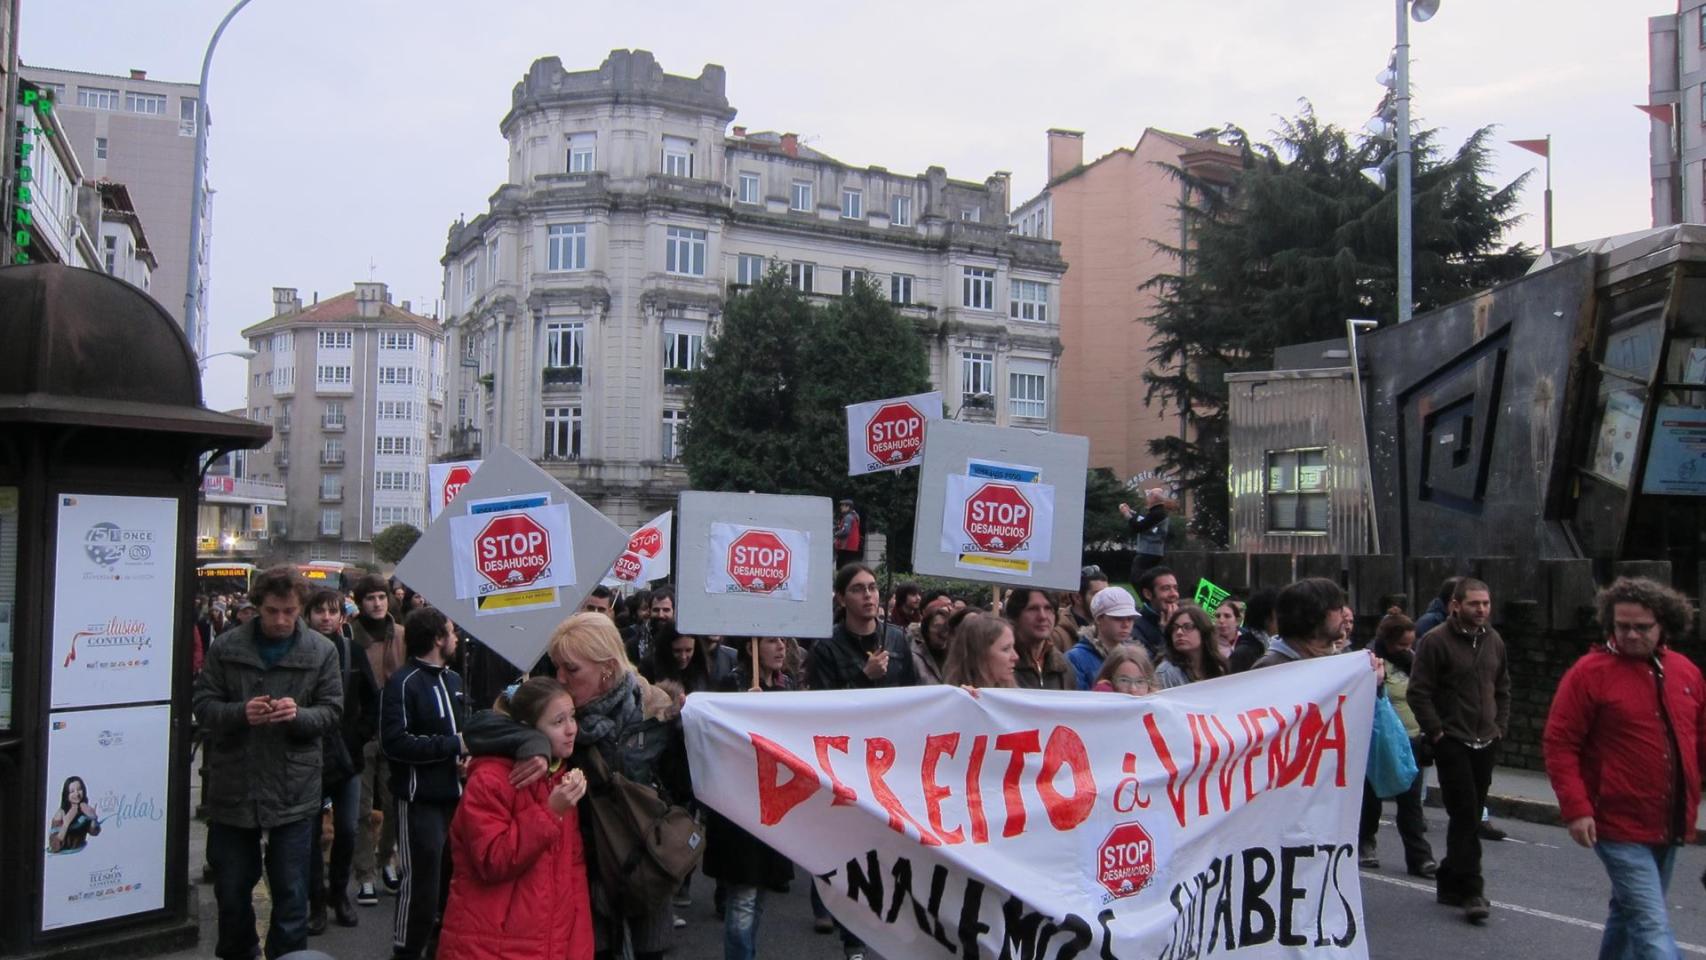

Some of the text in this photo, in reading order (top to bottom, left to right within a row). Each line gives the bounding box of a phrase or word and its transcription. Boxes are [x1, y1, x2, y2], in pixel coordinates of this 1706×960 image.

[15, 143, 34, 265] FORNOS
[872, 417, 920, 442] STOP
[872, 436, 920, 453] DESAHUCIOS
[446, 483, 466, 502] ST
[972, 500, 1027, 525] STOP
[123, 532, 153, 541] ONCE
[970, 522, 1025, 538] DESAHUCIOS
[482, 531, 542, 559] STOP
[631, 533, 659, 548] STOP
[484, 555, 545, 572] DESAHUCIOS
[617, 557, 641, 571] STOP
[734, 545, 786, 567] STOP
[733, 565, 784, 579] DESAHUCIOS
[748, 725, 1098, 847] DEREITO
[1142, 695, 1347, 828] VIVENDA
[1104, 840, 1149, 869] STOP
[1103, 863, 1150, 882] DESAHUCIOS
